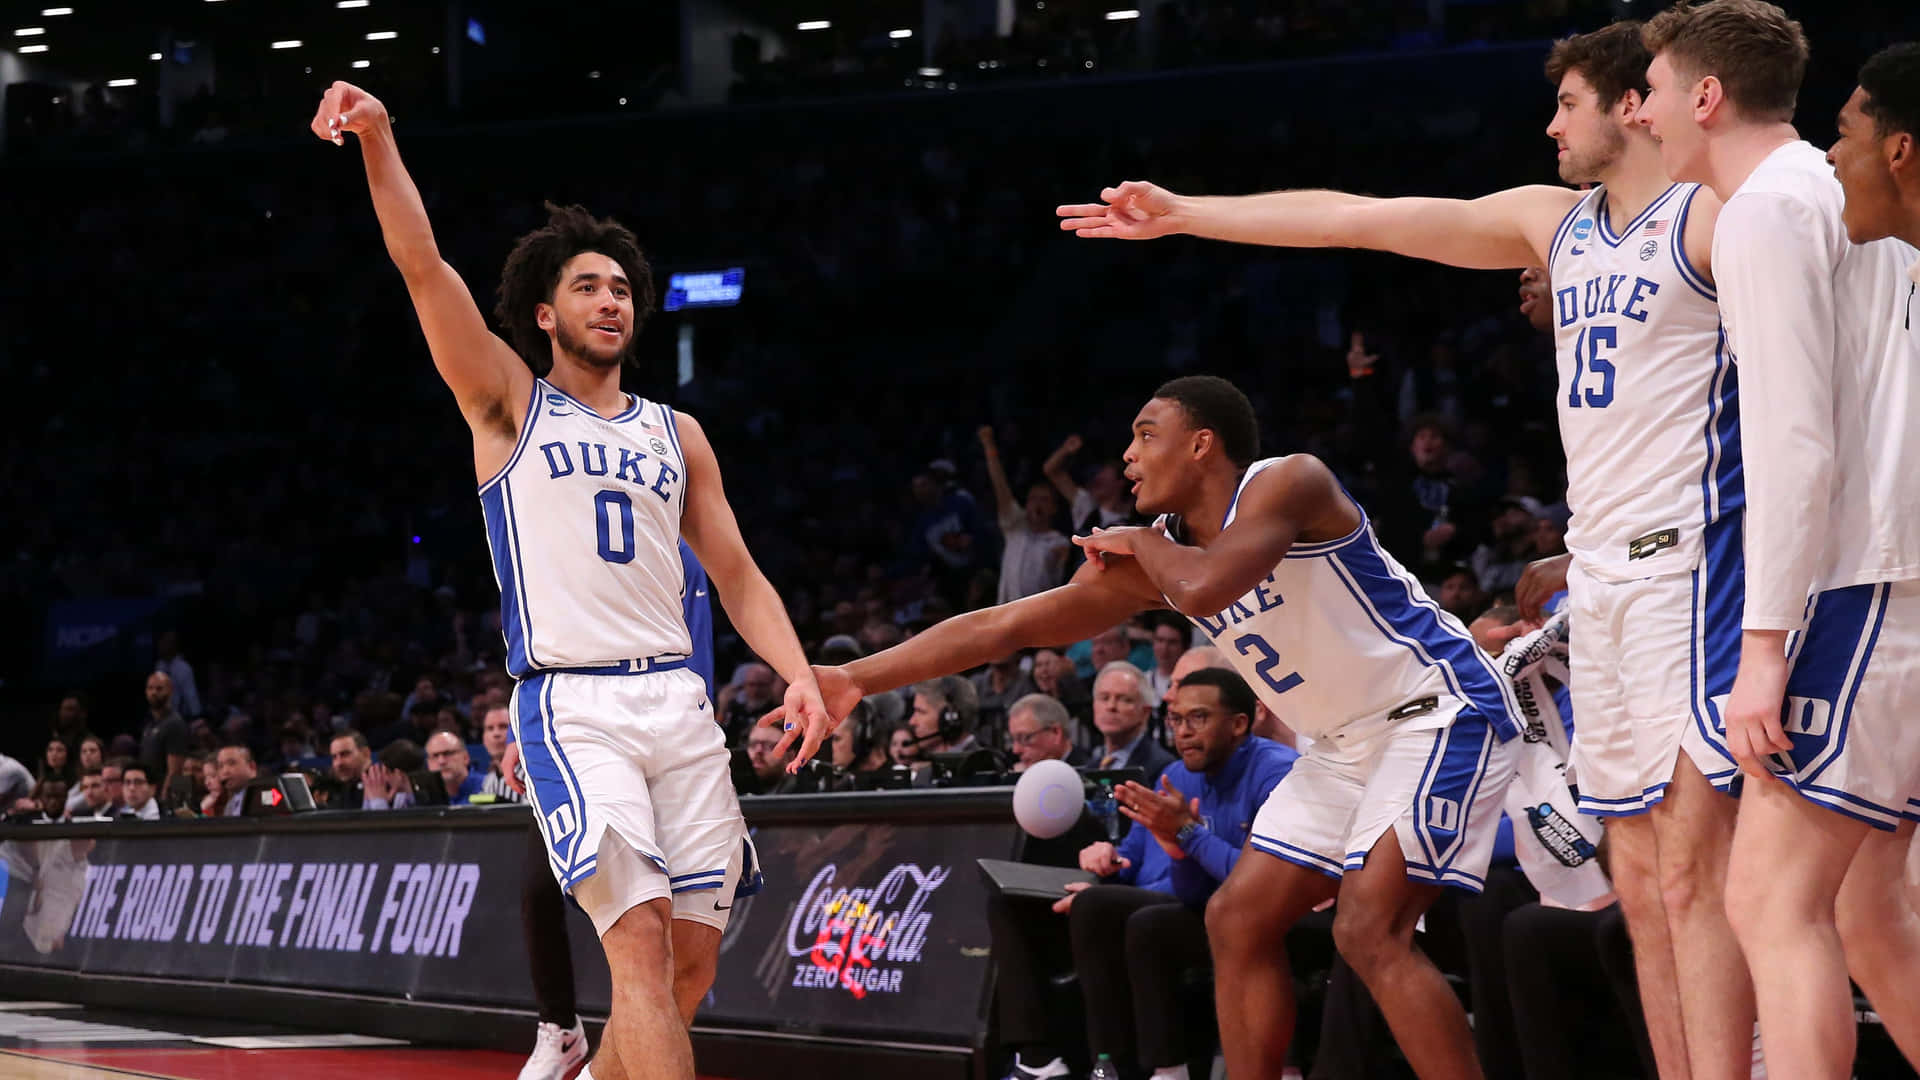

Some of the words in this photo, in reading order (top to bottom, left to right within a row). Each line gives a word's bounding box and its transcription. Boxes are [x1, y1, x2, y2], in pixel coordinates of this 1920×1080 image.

[1556, 273, 1661, 329] DUKE
[1568, 325, 1618, 409] 15
[539, 440, 679, 503] DUKE
[594, 489, 636, 565] 0
[1234, 633, 1305, 694] 2
[547, 803, 576, 845] D
[1427, 795, 1459, 831] D
[1543, 811, 1581, 844] MARCH
[1537, 824, 1584, 866] MADNESS
[70, 864, 128, 938] THE
[113, 864, 195, 943] ROAD
[185, 864, 233, 944] TO
[224, 863, 294, 948] THE
[278, 863, 380, 952] FINAL
[369, 863, 481, 959] FOUR
[787, 863, 952, 963] Coca-Cola
[791, 964, 840, 989] ZERO
[841, 967, 904, 993] SUGAR
